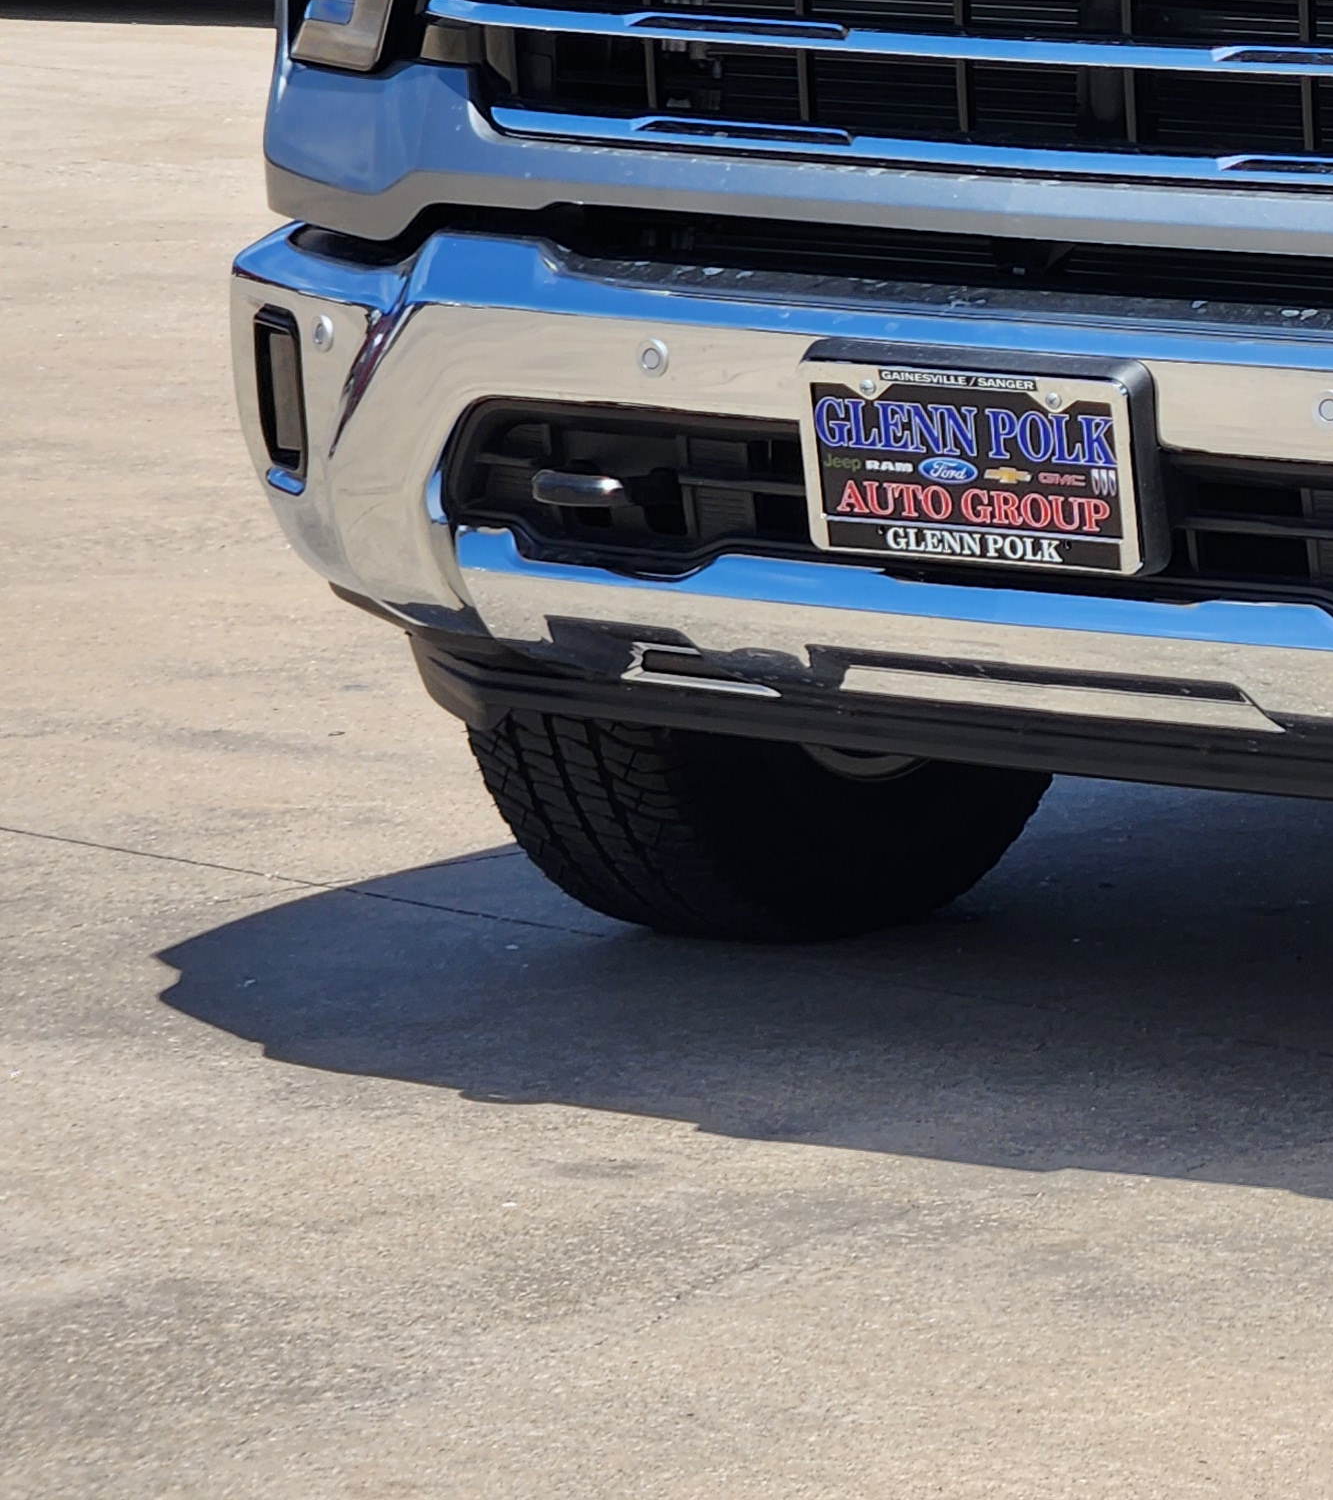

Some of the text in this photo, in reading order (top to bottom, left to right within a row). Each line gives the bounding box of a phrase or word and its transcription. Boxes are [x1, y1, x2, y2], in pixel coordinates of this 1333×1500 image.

[880, 370, 967, 386] GAINESVILLE
[977, 377, 1035, 390] SANGER
[815, 396, 1119, 467] GLENN POLK
[823, 453, 1086, 487] Jeep RAM Ford GMC
[836, 480, 1111, 532] AUTO GROUP
[886, 526, 1063, 563] GLENN POLK
